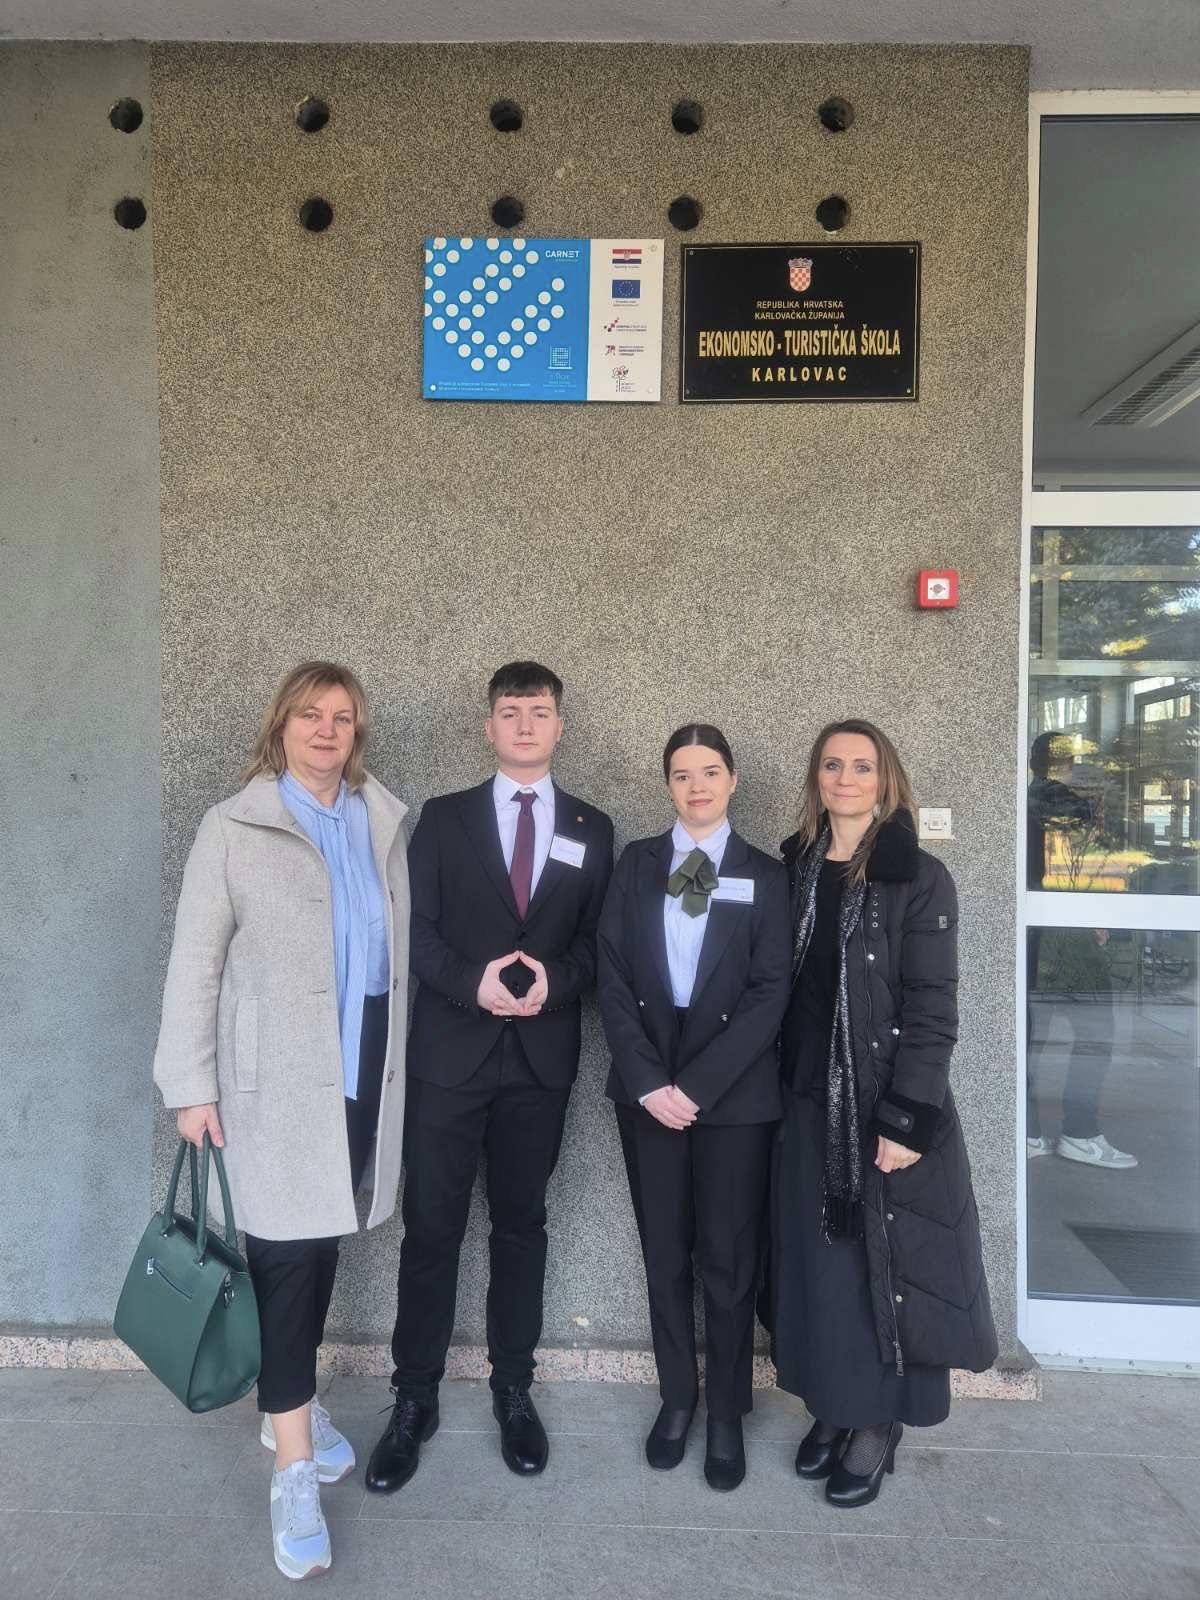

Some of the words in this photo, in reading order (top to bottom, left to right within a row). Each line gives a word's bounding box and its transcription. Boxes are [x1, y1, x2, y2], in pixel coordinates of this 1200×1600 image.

[545, 250, 580, 258] CARNET
[756, 300, 800, 309] REPUBLIKA
[803, 300, 844, 309] HRVATSKA
[754, 309, 807, 320] KARLOVAČKA
[808, 309, 845, 320] ŽUPANIJA
[699, 329, 775, 357] EKONOMSKO
[784, 324, 857, 356] TURISTIČKA
[861, 323, 901, 356] ŠKOLA
[751, 366, 848, 382] KARLOVAC
